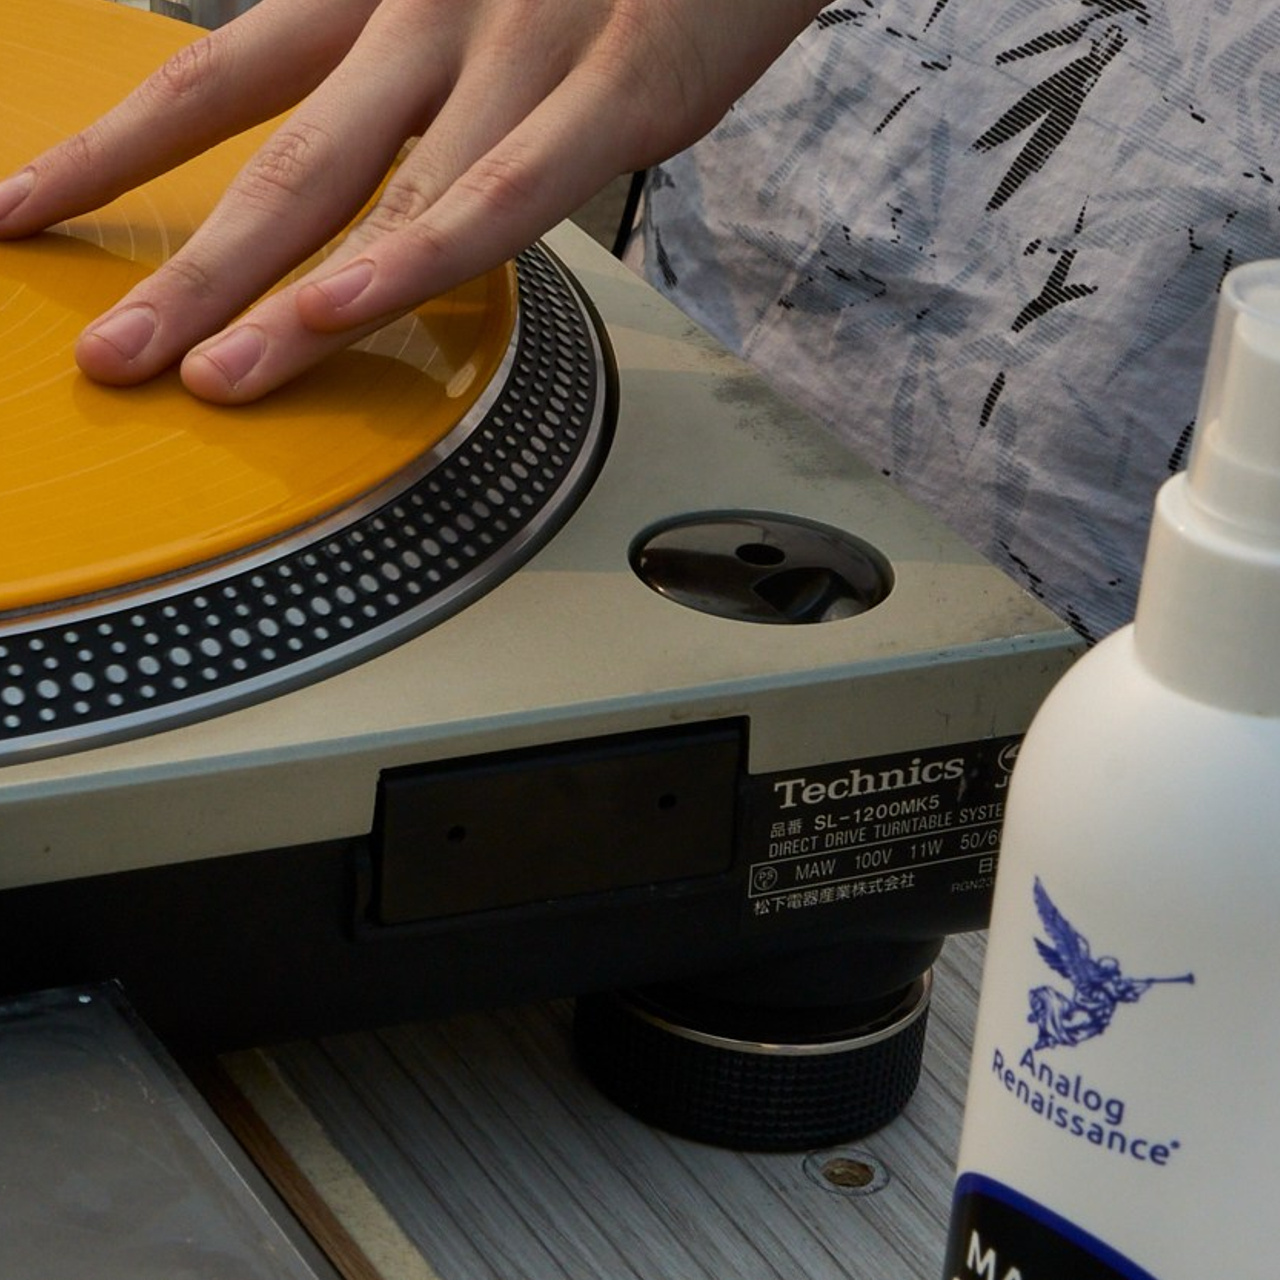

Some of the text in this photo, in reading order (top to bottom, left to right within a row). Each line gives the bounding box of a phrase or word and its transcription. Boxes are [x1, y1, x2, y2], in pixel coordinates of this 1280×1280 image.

[773, 757, 965, 809] Technics
[769, 802, 1003, 859] DIRECT DRIVE TURNTABLE SYSTE
[770, 794, 940, 839] 品番 SL-1200MK5
[795, 859, 836, 881] MAW
[855, 848, 893, 870] 100V
[910, 839, 943, 860] 11W
[1019, 1047, 1125, 1127] Analog
